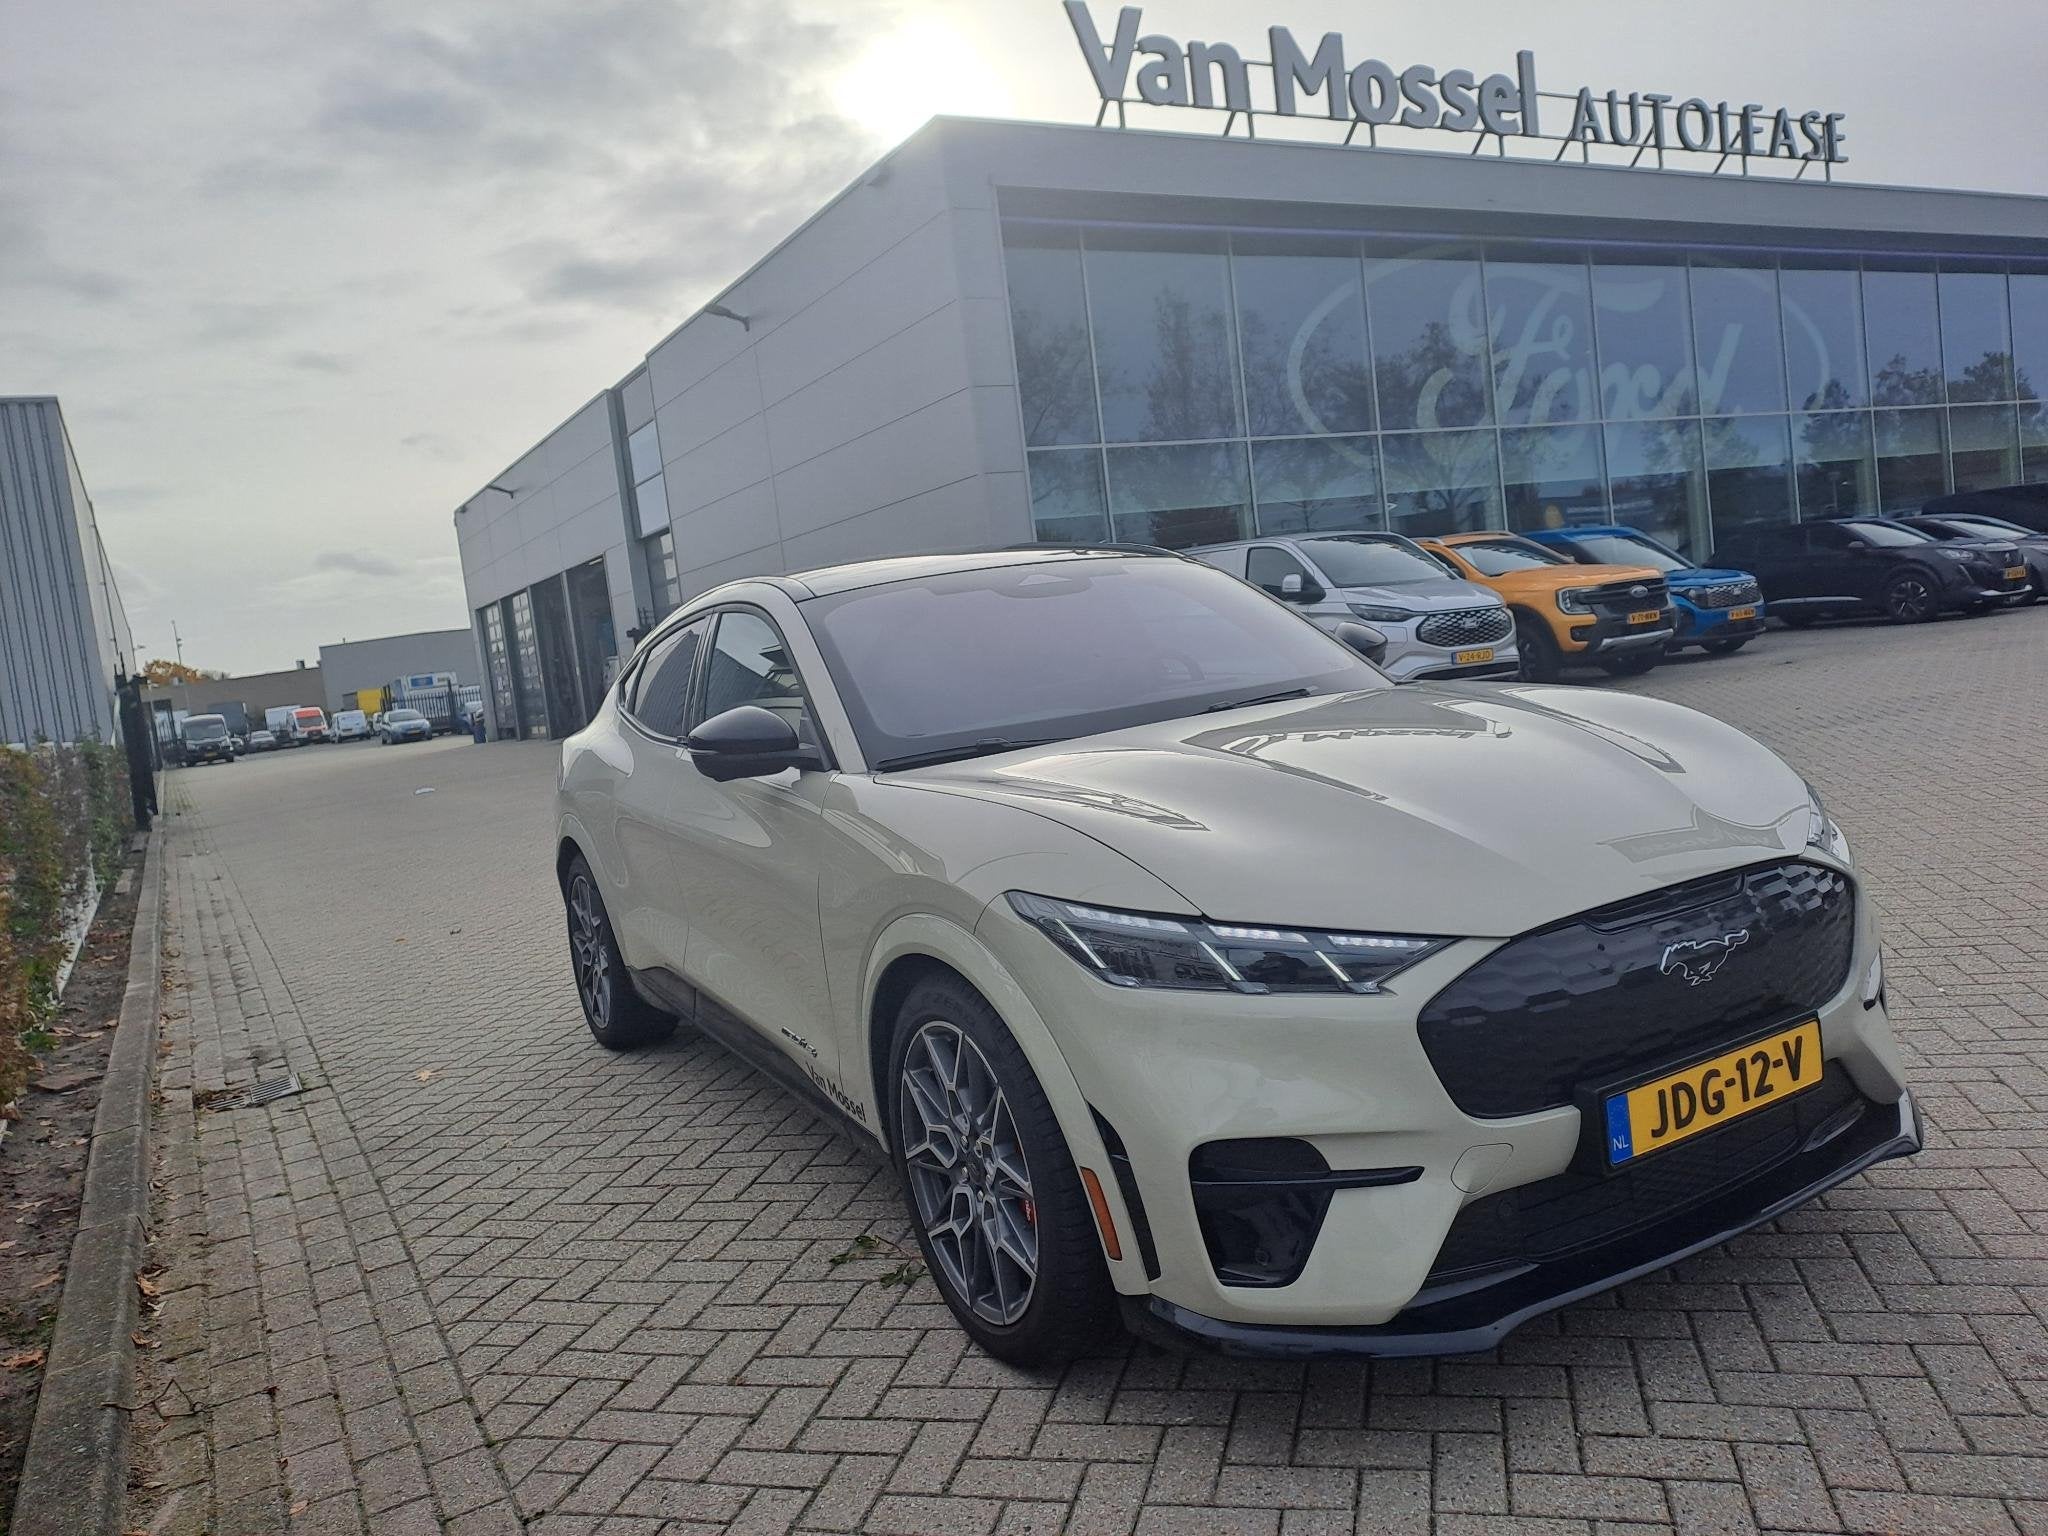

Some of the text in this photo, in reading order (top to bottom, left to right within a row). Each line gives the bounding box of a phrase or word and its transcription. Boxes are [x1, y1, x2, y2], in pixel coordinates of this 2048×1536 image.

[1064, 0, 1849, 163] Van Mossel AUTOLEASE
[1417, 268, 1743, 468] Ford
[806, 1061, 867, 1123] Van Mossel
[1651, 1036, 1803, 1138] JDG-12-V
[1613, 1135, 1629, 1151] NL
